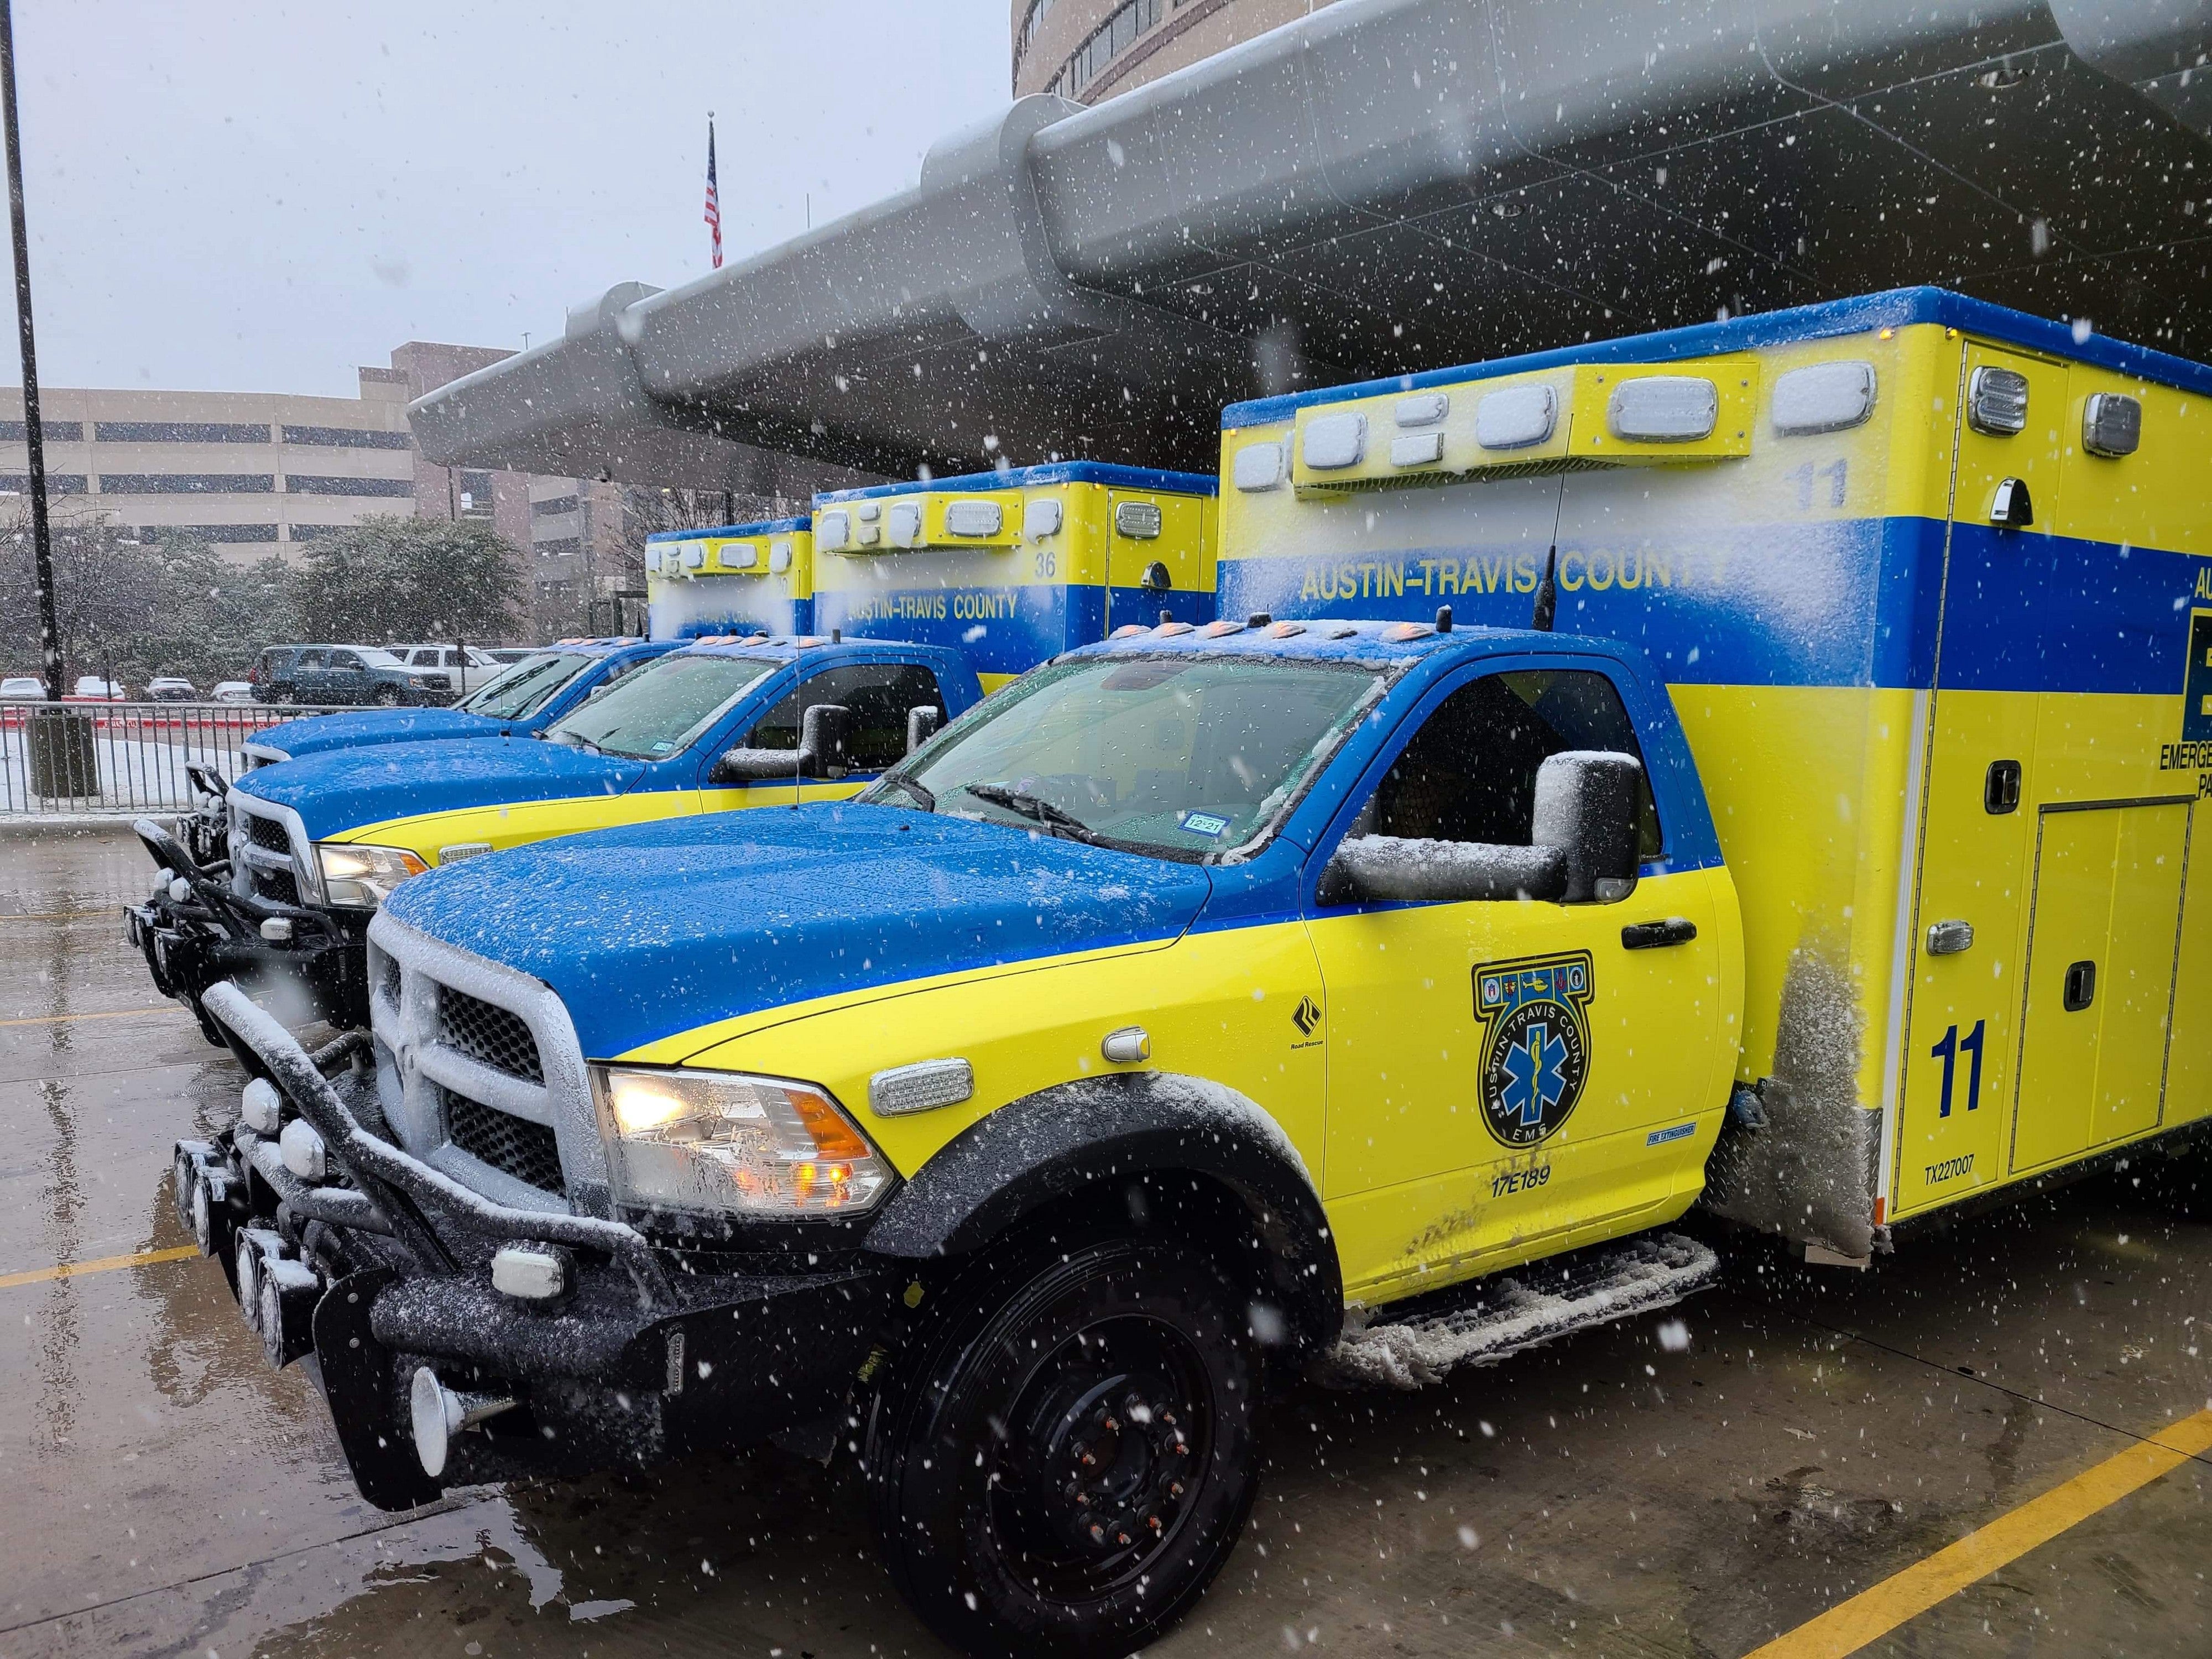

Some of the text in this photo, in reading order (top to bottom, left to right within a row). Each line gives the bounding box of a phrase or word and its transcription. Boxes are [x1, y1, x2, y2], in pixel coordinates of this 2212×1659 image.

[1784, 458, 1847, 511] 11
[1035, 552, 1055, 578] 36
[1301, 555, 1538, 600] AUSTIN-TRAVIS
[954, 594, 1018, 619] COUNTY
[1489, 1005, 1580, 1110] AUSTIN-TRAVIS COUNTY
[1931, 1019, 1985, 1118] 11
[1512, 1123, 1546, 1142] EMS
[1648, 1125, 1694, 1144] FIRE EXTINGUISHER
[1492, 1165, 1551, 1198] 17E189
[1925, 1154, 1974, 1186] TX227007
